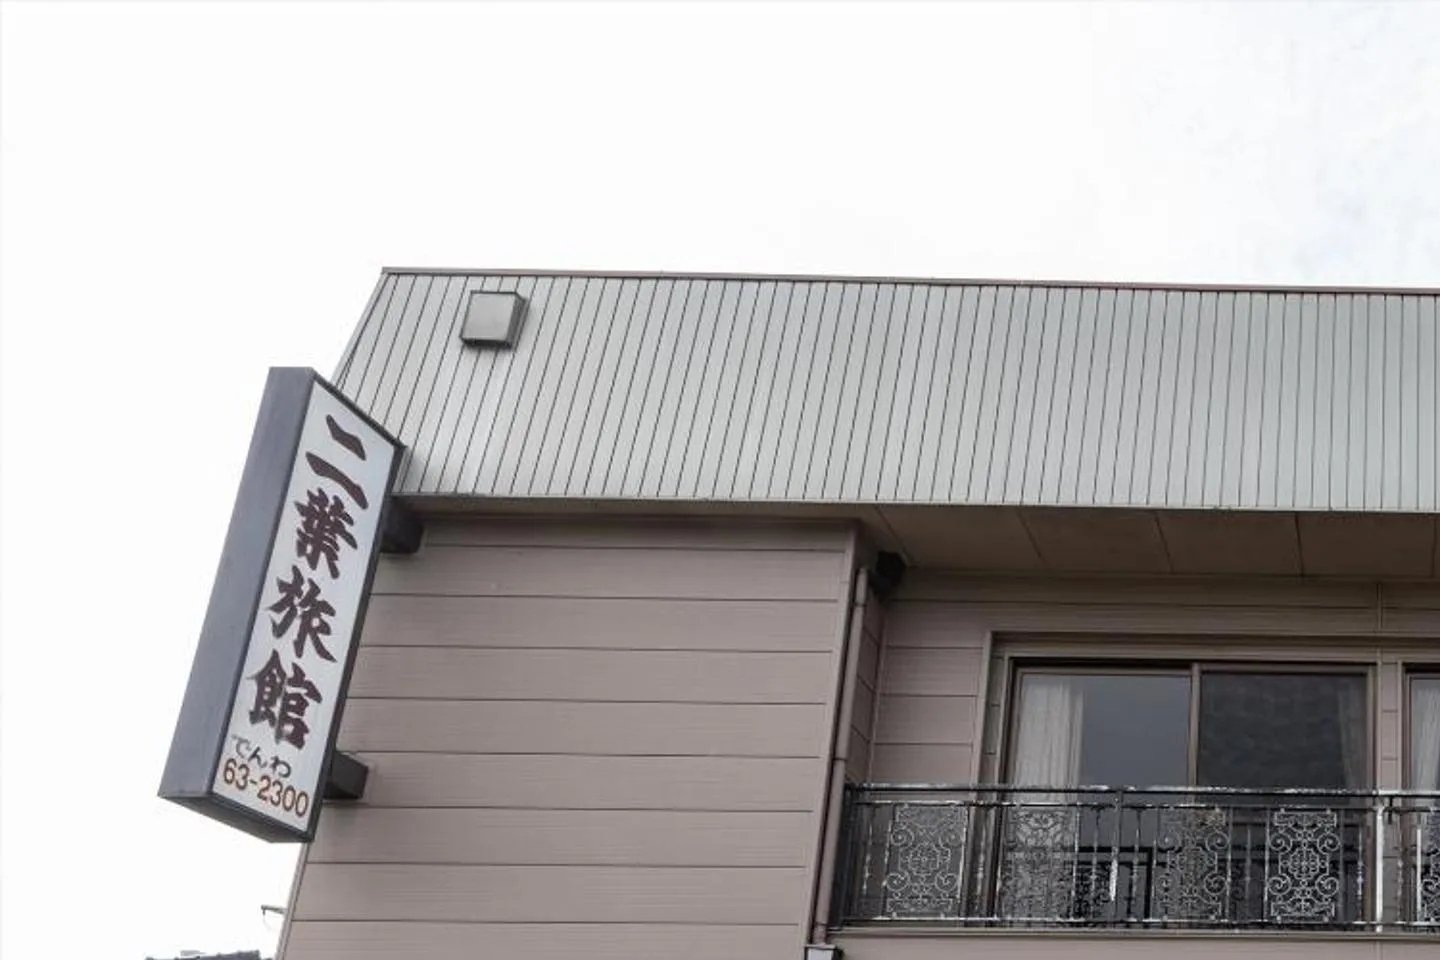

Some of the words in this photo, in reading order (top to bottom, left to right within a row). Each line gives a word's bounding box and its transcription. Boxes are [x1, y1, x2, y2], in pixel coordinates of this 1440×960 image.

[231, 733, 292, 778] でんわ
[223, 758, 309, 818] 63-2300
